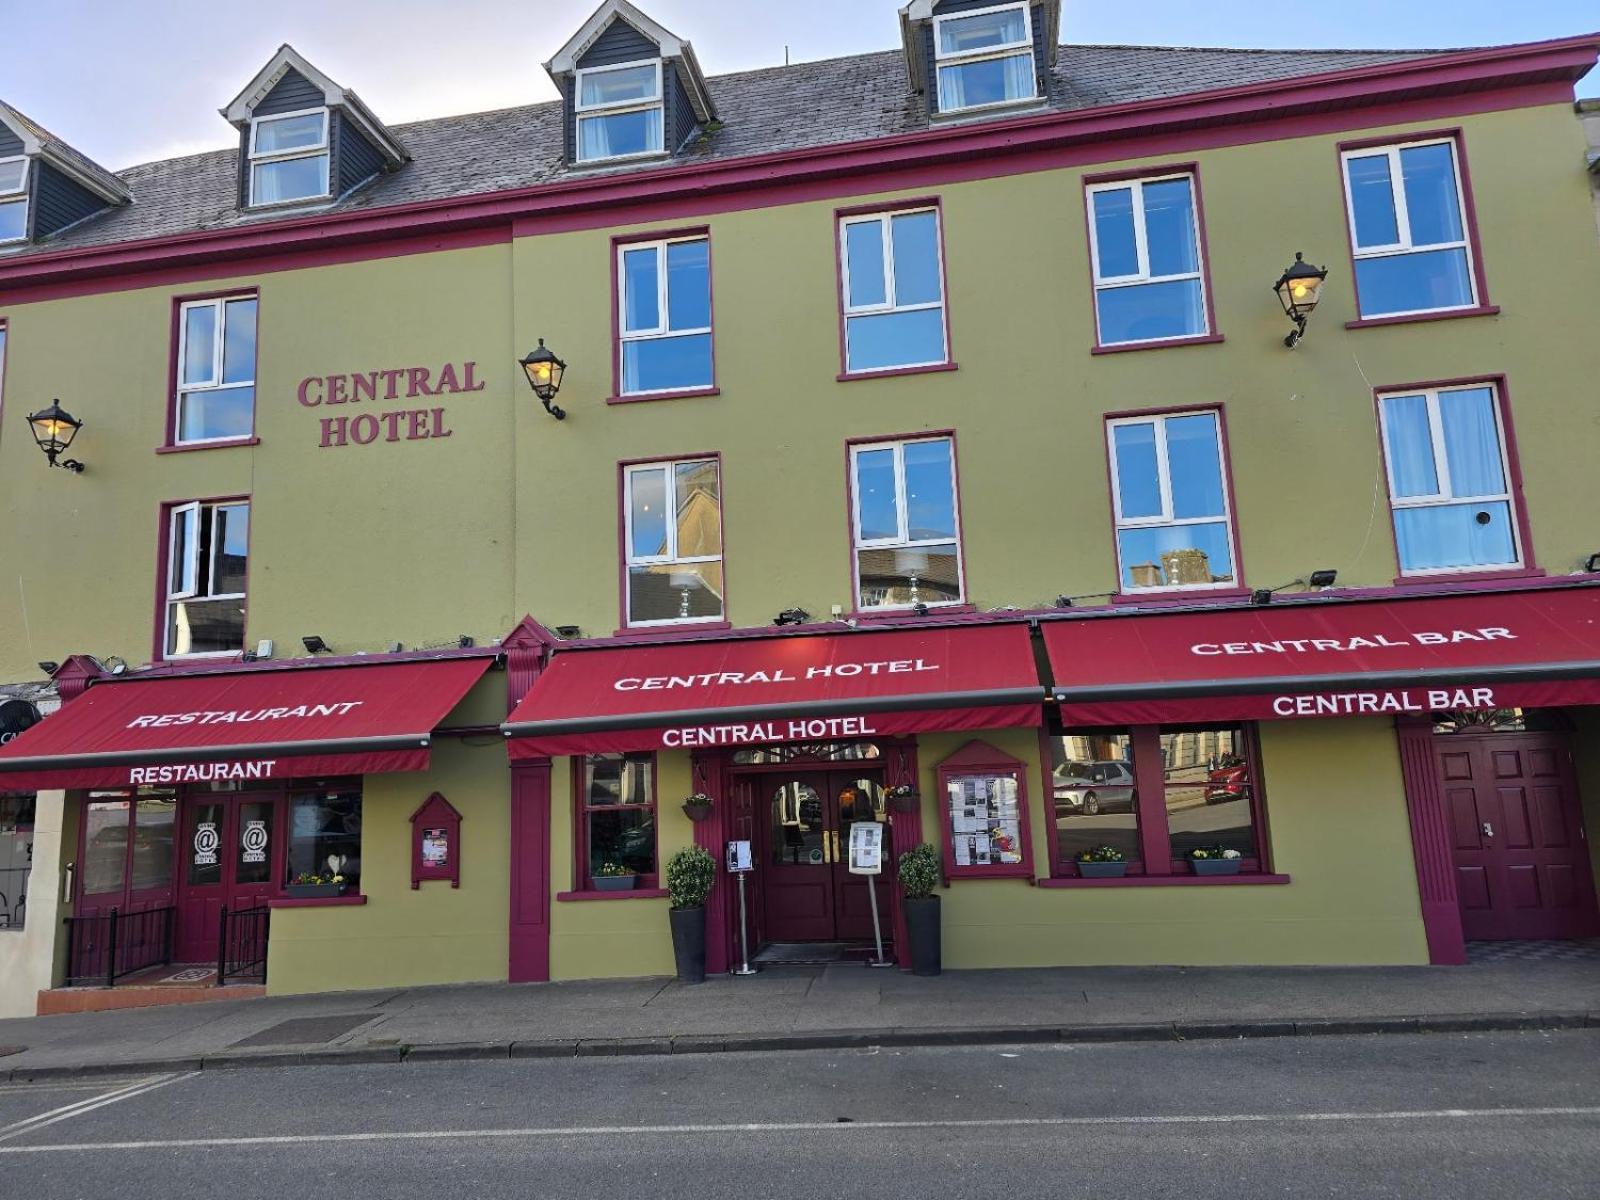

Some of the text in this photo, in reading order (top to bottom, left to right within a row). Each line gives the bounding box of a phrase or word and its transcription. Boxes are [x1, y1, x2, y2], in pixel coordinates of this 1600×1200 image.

[297, 361, 485, 407] CENTRAL
[318, 407, 452, 448] HOTEL
[1191, 627, 1518, 656] CENTRAL BAR
[614, 658, 939, 692] CENTRAL HOTEL
[126, 701, 363, 729] RESTAURANT
[1272, 687, 1496, 716] CENTRAL BAR
[662, 716, 876, 748] CENTRAL HOTEL
[129, 760, 276, 784] RESTAURANT
